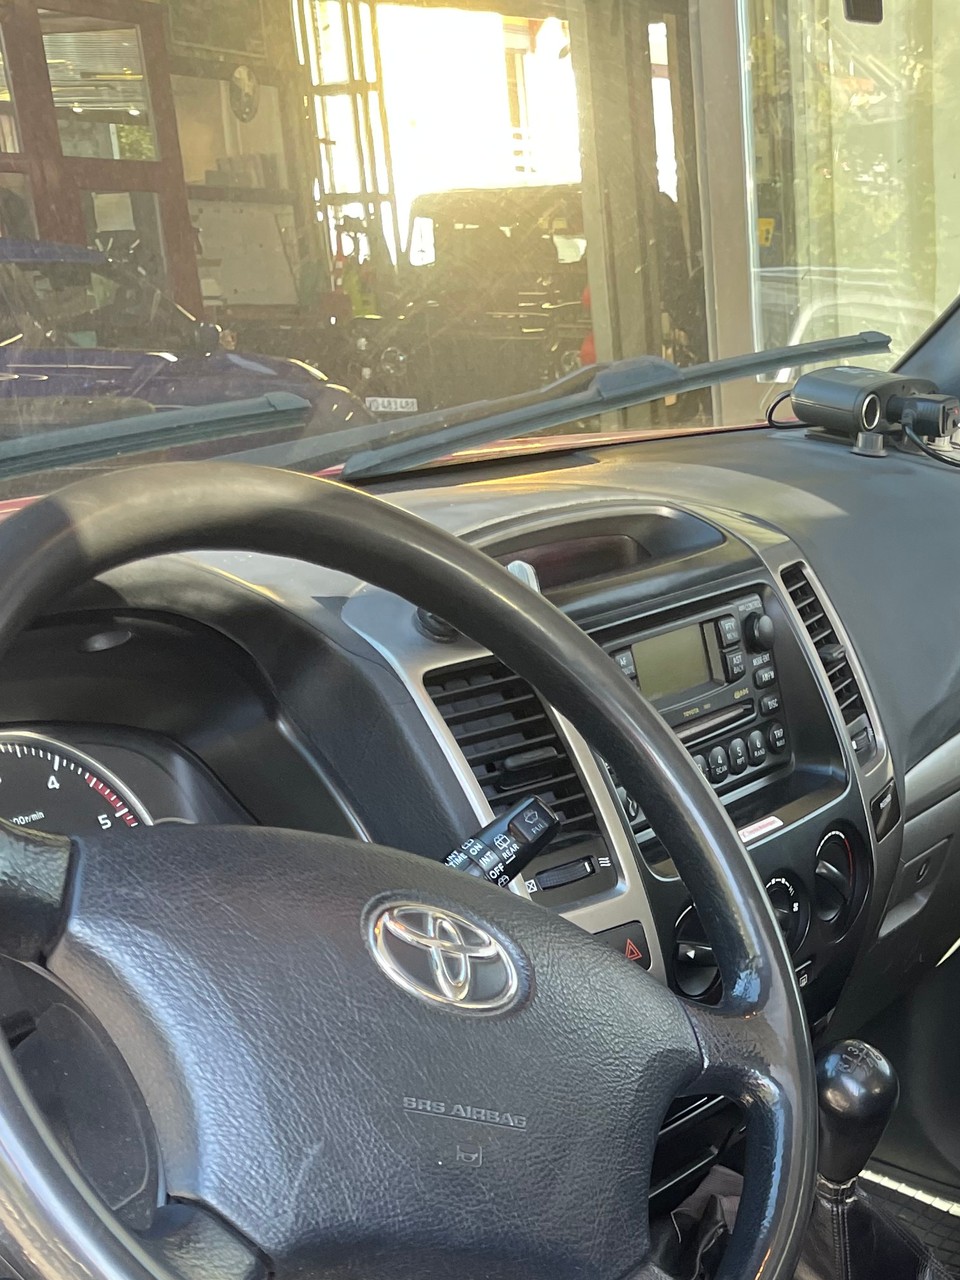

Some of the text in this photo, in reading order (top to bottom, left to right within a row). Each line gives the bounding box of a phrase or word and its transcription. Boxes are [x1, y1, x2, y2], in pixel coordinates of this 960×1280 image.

[47, 775, 60, 789] 4
[97, 814, 112, 830] 5
[469, 842, 483, 856] ON
[501, 843, 520, 860] REAR
[479, 850, 494, 867] INT
[489, 862, 505, 879] OFF
[402, 1096, 527, 1127] SRS AIRBAG
